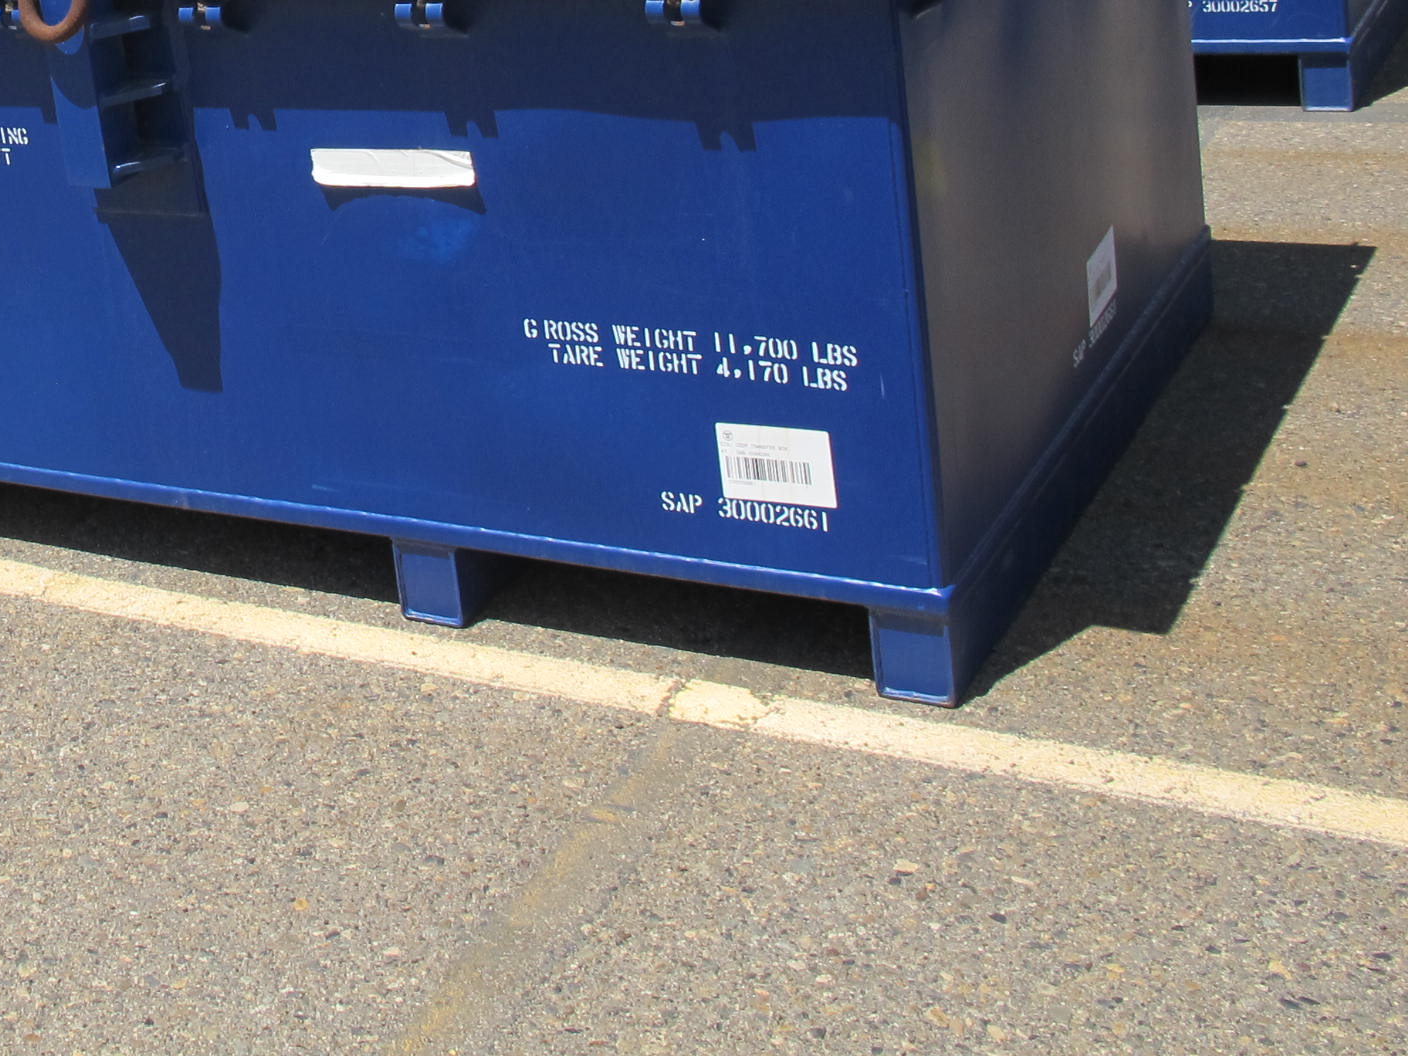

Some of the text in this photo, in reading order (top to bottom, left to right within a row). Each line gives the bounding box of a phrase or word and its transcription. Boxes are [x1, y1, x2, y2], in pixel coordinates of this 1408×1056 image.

[1202, 0, 1278, 13] 30002657
[524, 318, 599, 343] GROSS
[612, 324, 696, 351] WEIGHT
[811, 341, 858, 367] LBS
[548, 343, 604, 367] TARE
[616, 348, 702, 375] WEIGHT
[802, 366, 848, 391] LBS
[661, 491, 828, 532] SAP 30002661
